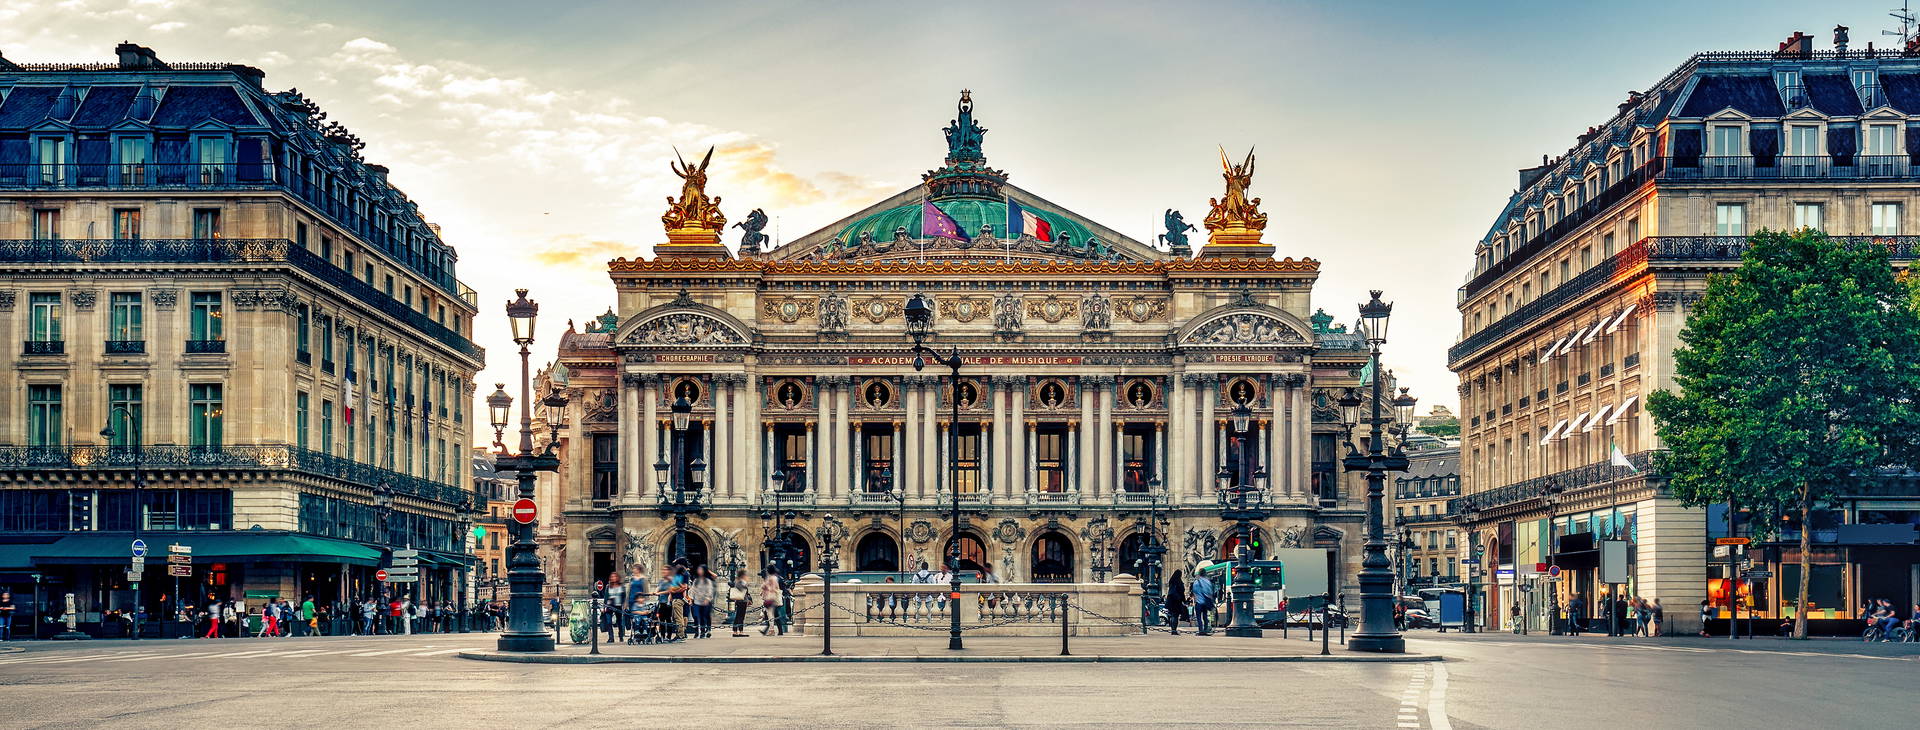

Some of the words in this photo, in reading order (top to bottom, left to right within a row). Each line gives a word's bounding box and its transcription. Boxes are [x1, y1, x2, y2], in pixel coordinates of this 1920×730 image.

[871, 357, 915, 365] ACADEM
[990, 357, 1004, 365] DE
[1011, 357, 1059, 365] MUSIQUE
